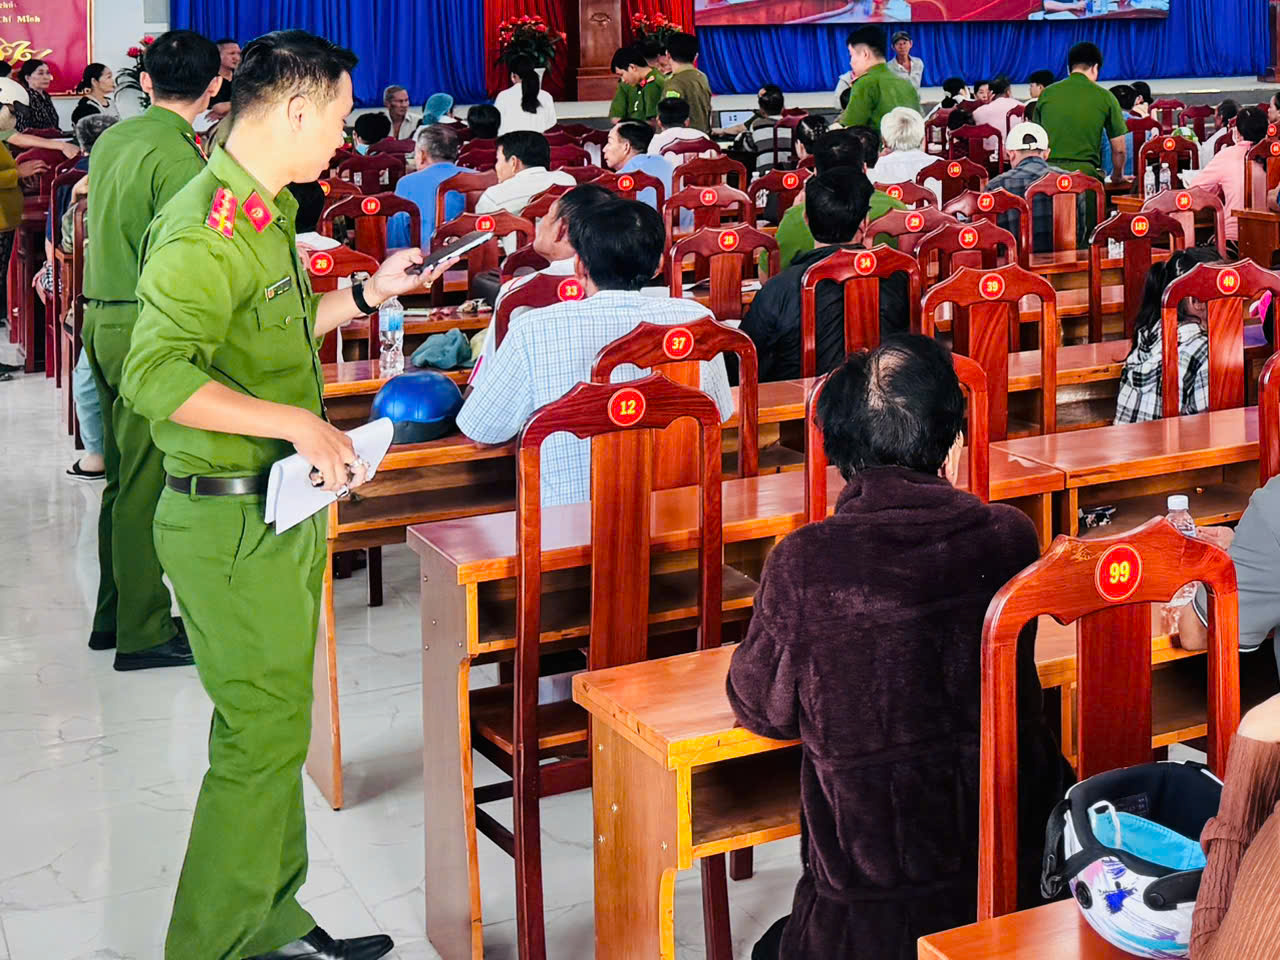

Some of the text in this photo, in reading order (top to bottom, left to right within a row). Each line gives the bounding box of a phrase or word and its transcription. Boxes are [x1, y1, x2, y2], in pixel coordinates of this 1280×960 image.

[704, 192, 714, 201] 21
[964, 233, 974, 243] 35
[315, 258, 328, 270] 26
[860, 257, 872, 269] 34
[986, 280, 1000, 293] 39
[1223, 275, 1236, 288] 40
[564, 285, 579, 297] 33
[671, 337, 687, 350] 37
[618, 399, 637, 416] 12
[1109, 561, 1132, 585] 99
